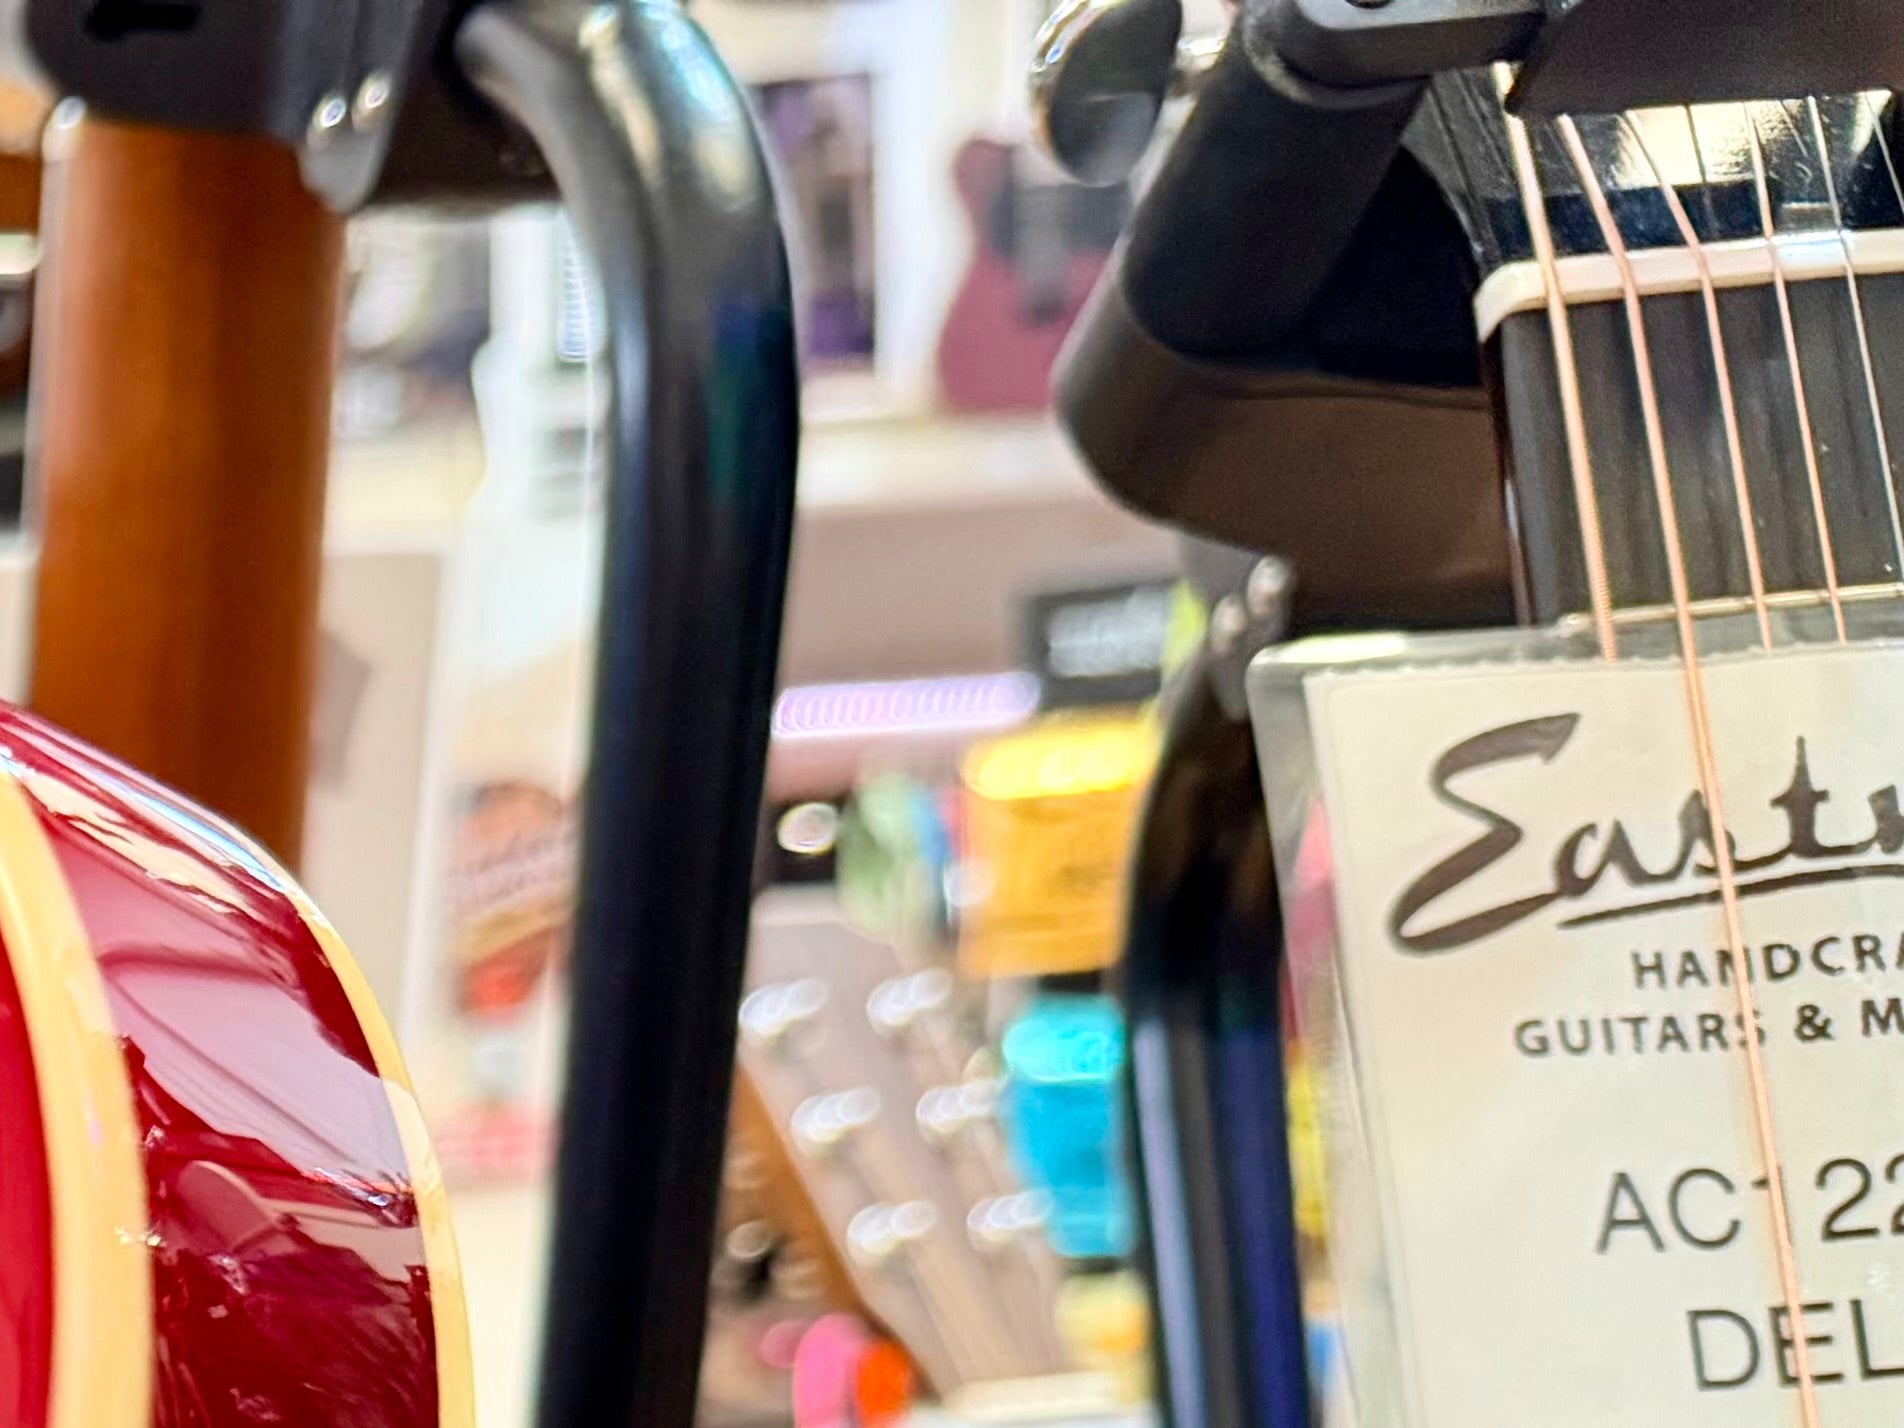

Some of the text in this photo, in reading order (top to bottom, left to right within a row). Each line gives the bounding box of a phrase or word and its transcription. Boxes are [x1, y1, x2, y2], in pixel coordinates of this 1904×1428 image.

[1631, 933, 1904, 989] HANDCR
[1794, 1003, 1835, 1043] &
[1685, 1296, 1904, 1391] DEL
